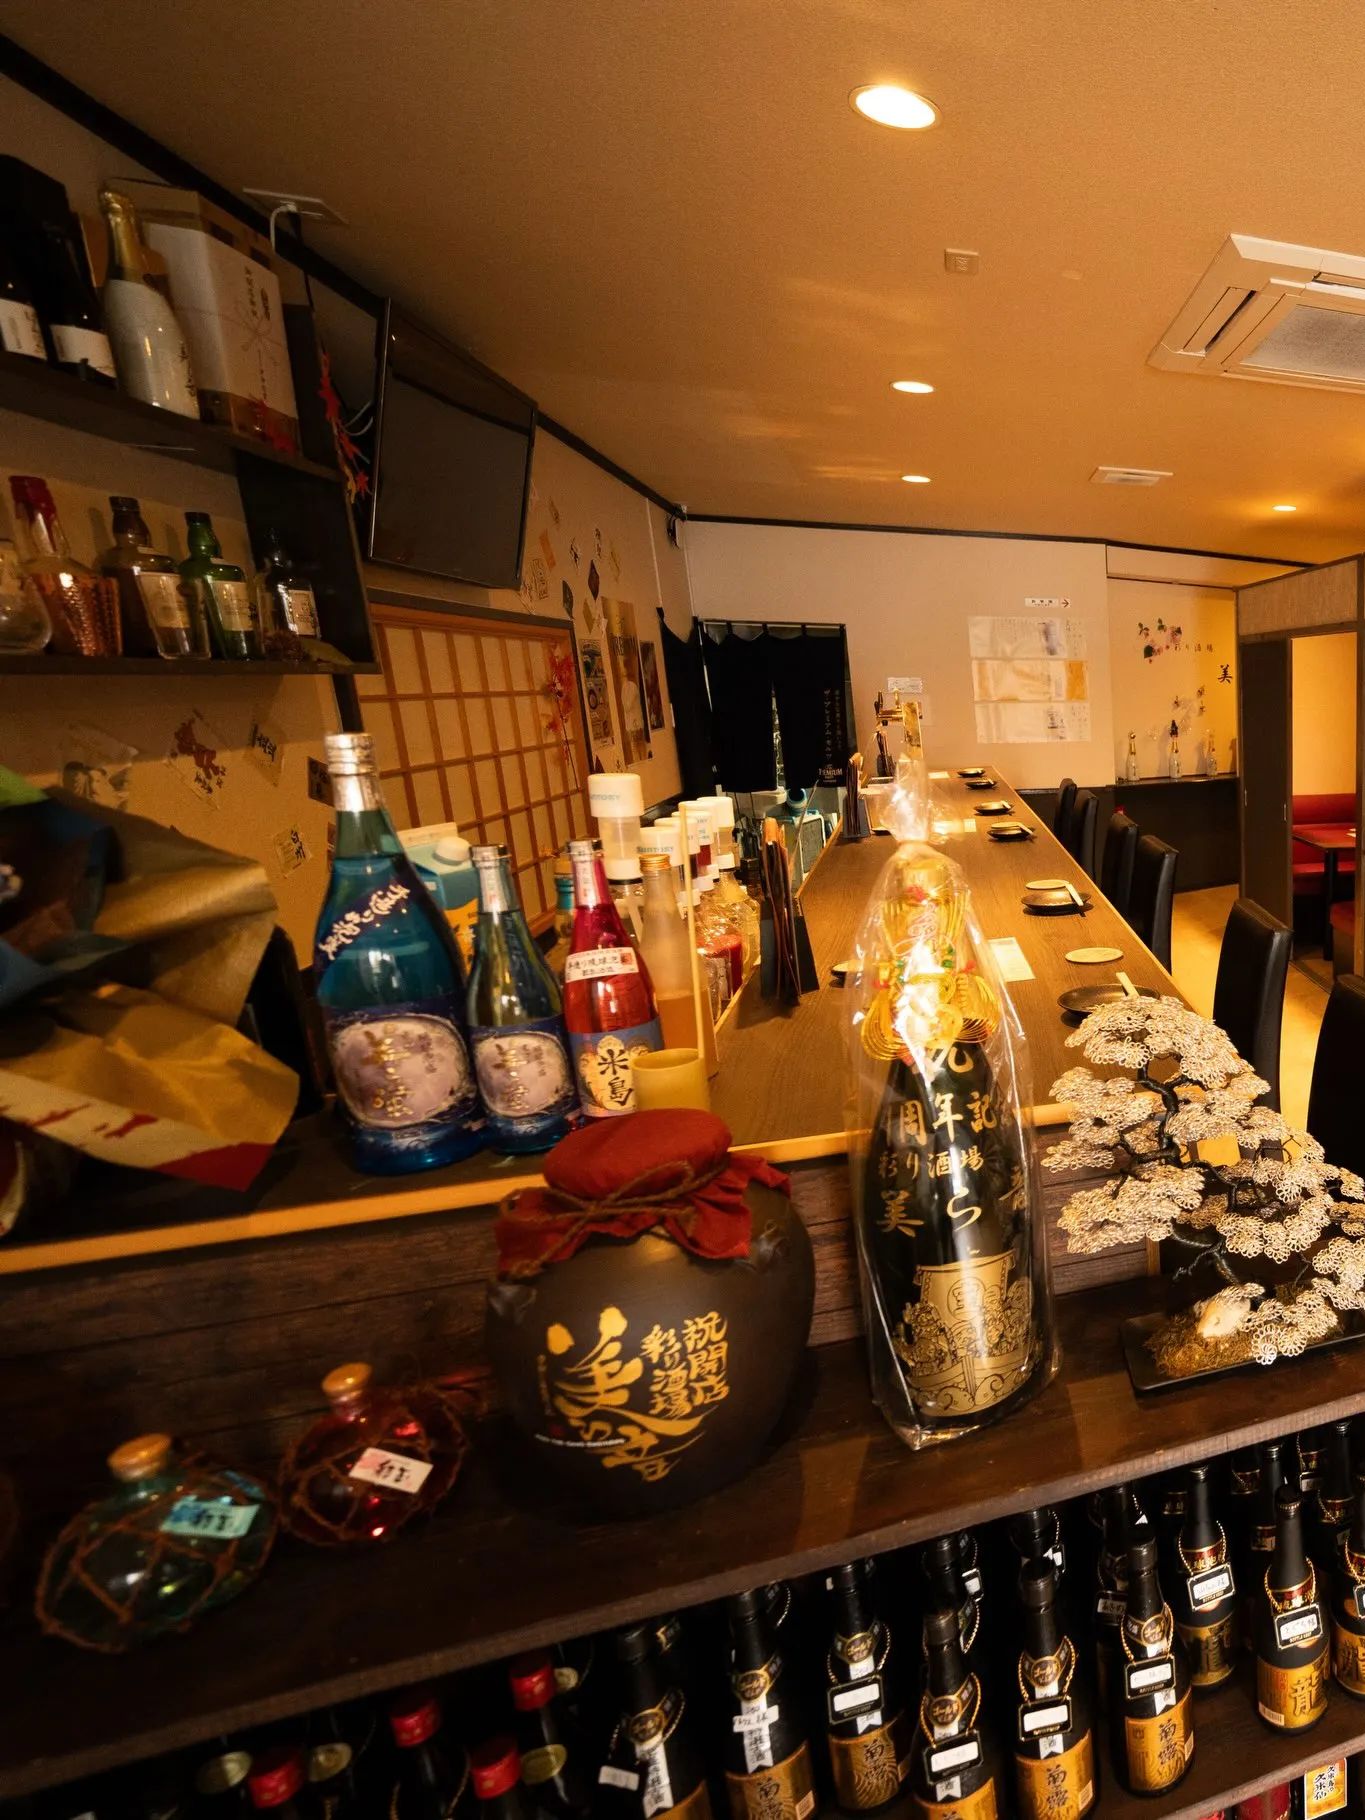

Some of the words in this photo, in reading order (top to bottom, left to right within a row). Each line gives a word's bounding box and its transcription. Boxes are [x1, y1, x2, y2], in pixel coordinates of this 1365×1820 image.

[1217, 664, 1233, 684] 美
[598, 1048, 633, 1107] 米島
[1313, 1773, 1327, 1801] 久米仙
